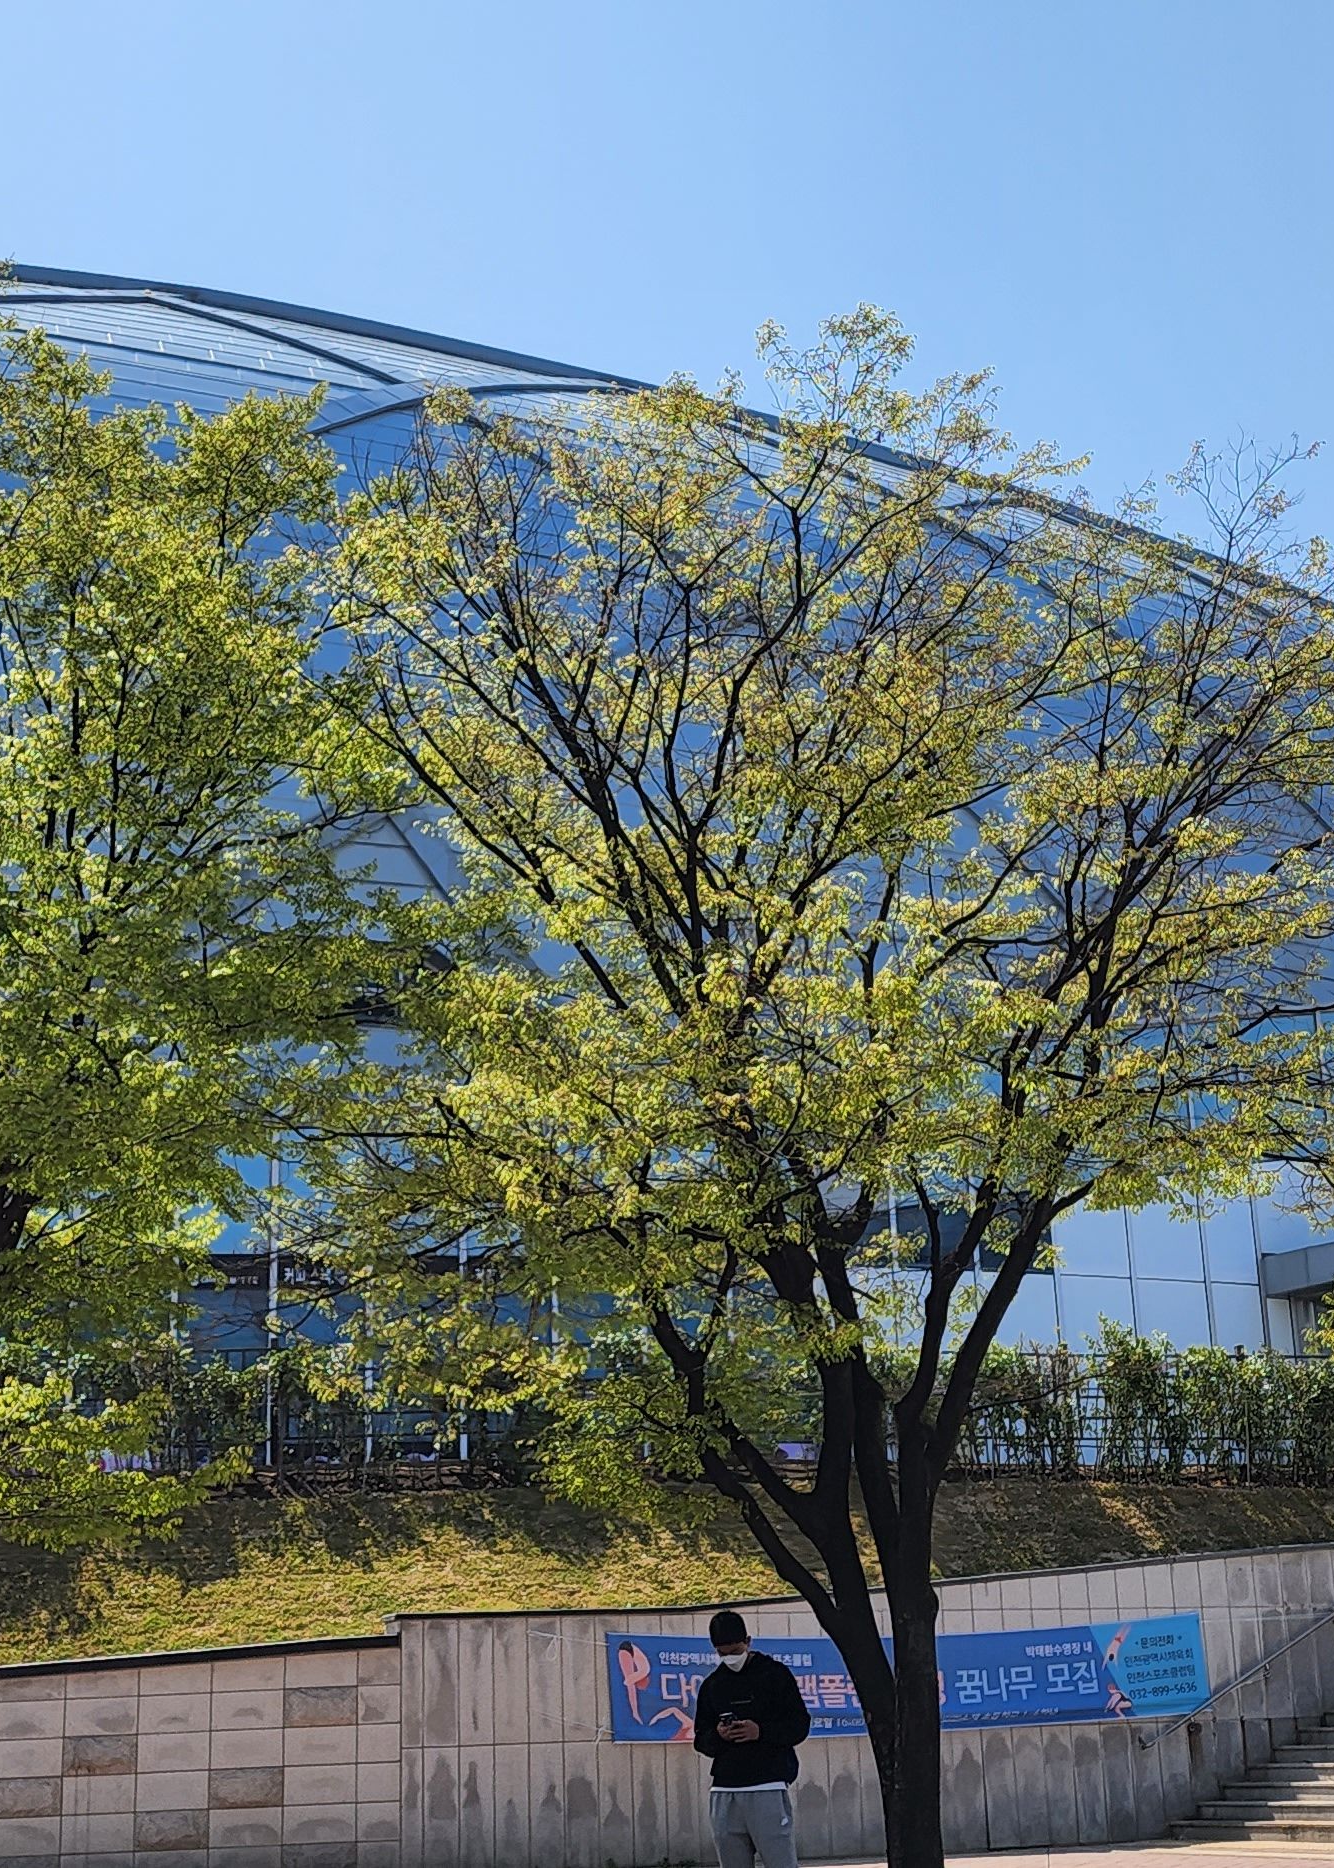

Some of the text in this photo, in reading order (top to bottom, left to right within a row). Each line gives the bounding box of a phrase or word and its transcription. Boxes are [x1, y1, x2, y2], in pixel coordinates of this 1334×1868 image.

[1025, 1641, 1093, 1658] 박태환수영장 내
[1140, 1635, 1174, 1649] 문의전화
[1124, 1648, 1194, 1668] 인천광역시체육회
[955, 1666, 1037, 1704] 꿈나무
[1047, 1659, 1100, 1695] 모집
[1126, 1664, 1195, 1684] 인천스포츠클럽팀
[1128, 1681, 1198, 1700] 032-899-5636
